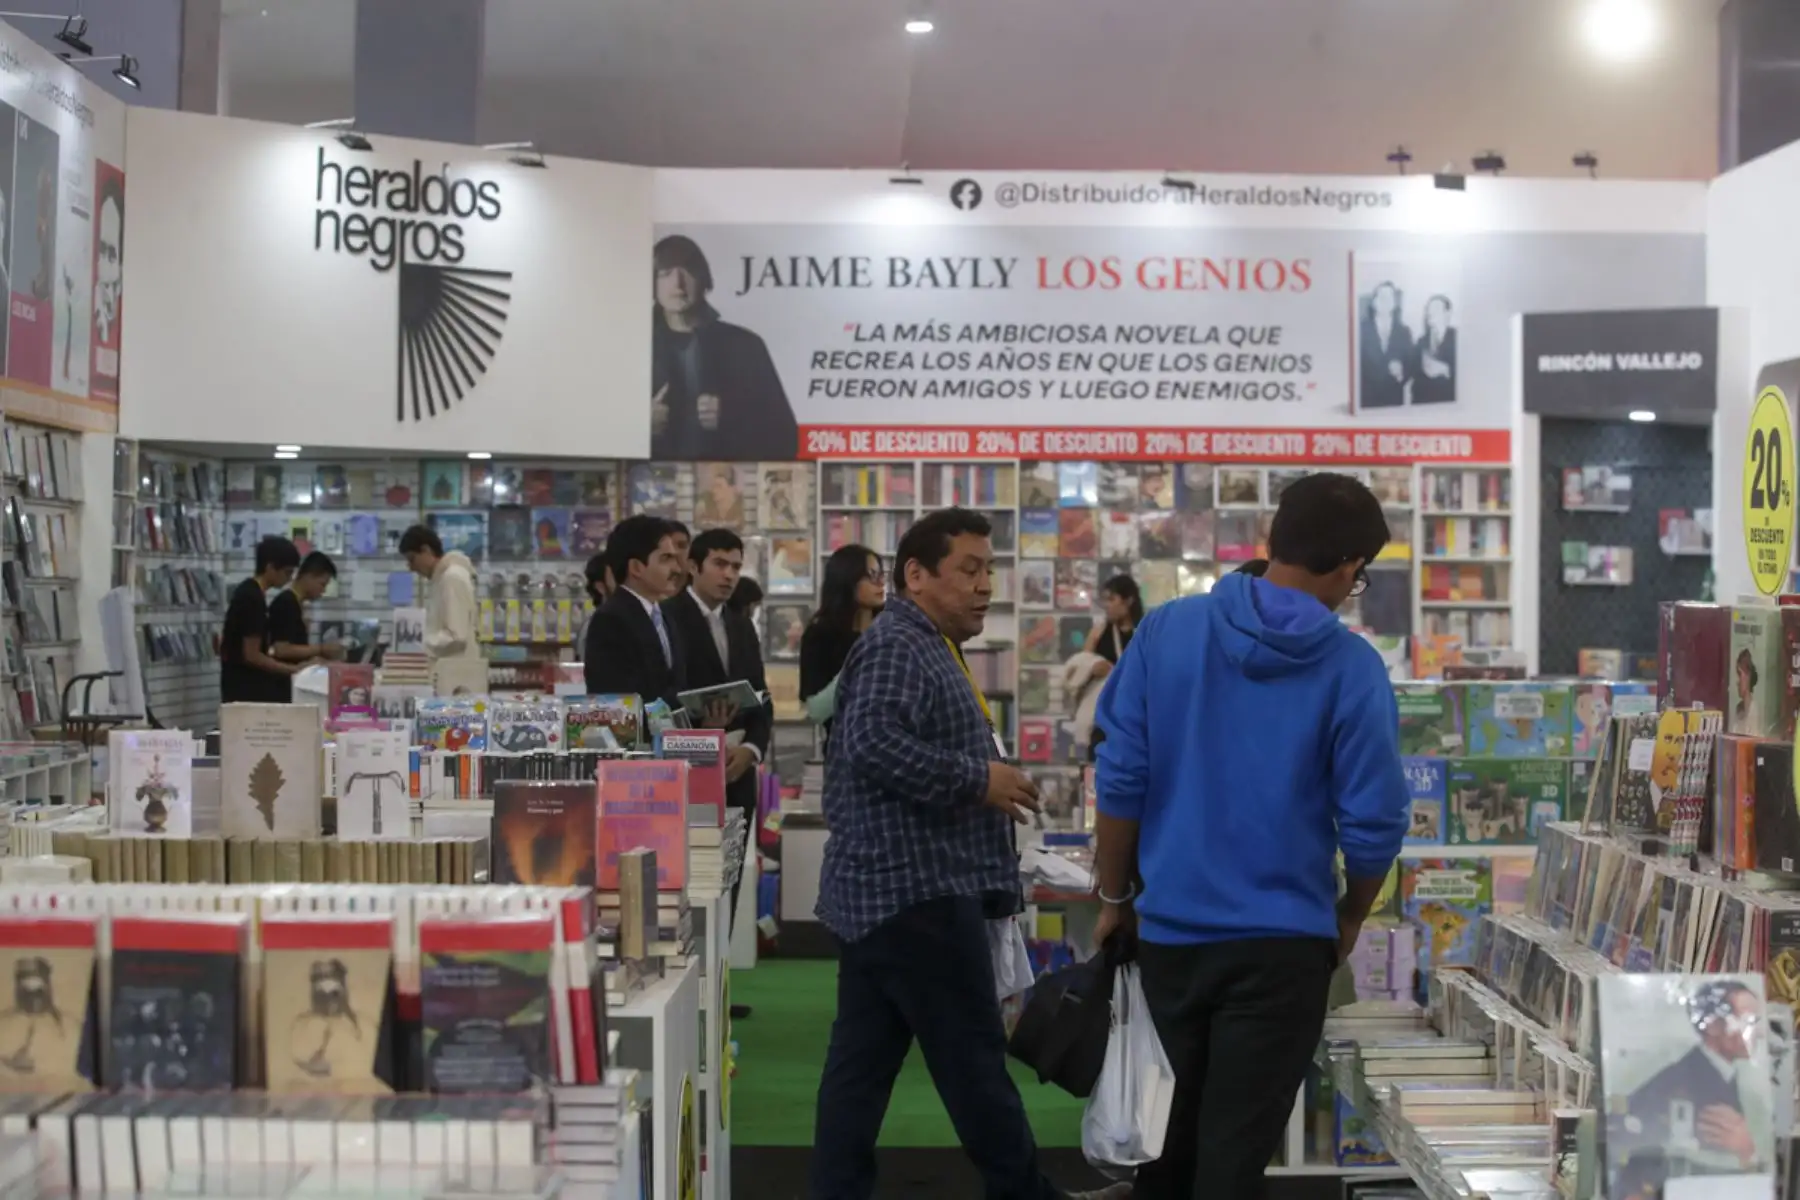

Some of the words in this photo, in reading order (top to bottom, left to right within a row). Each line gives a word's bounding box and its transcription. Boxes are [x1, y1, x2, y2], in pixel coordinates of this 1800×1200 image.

[316, 147, 501, 221] heraldos
[315, 209, 465, 272] negros
[735, 255, 871, 297] JAIME
[886, 257, 1019, 290] BAYLY
[1036, 256, 1121, 291] LOS
[1136, 257, 1312, 293] GENIOS
[893, 318, 952, 343] MÁS
[957, 323, 1108, 345] AMBICIOSA
[1115, 324, 1220, 345] NOVELA
[1227, 325, 1283, 347] QUE
[810, 351, 915, 371] RECREA
[921, 351, 971, 371] LOS
[976, 346, 1051, 372] AÑOS
[1056, 352, 1092, 372] EN
[1098, 352, 1154, 374] QUE
[1159, 353, 1208, 373] LOS
[1213, 353, 1313, 375] GENIOS
[1538, 351, 1612, 373] RINCÓN
[1616, 352, 1702, 371] VALLEJO
[808, 379, 917, 399] FUERON
[922, 379, 1031, 400] AMIGOS
[1040, 380, 1056, 399] Y
[1059, 380, 1149, 401] LUEGO
[808, 431, 847, 453] 20%
[850, 431, 871, 453] DE
[875, 431, 970, 453] DESCUENTO
[976, 431, 1015, 454] 20%
[1018, 431, 1039, 454] DE
[1044, 431, 1138, 454] DESCUENTO
[1145, 432, 1184, 454] 20%
[1187, 432, 1208, 454] DE
[1212, 432, 1306, 454] DESCUENTO
[1312, 433, 1351, 456] 20%
[1354, 433, 1375, 456] DE
[1379, 433, 1473, 456] DESCUENTO
[1750, 527, 1784, 544] DESCUENTO
[666, 741, 716, 749] CASANOVA
